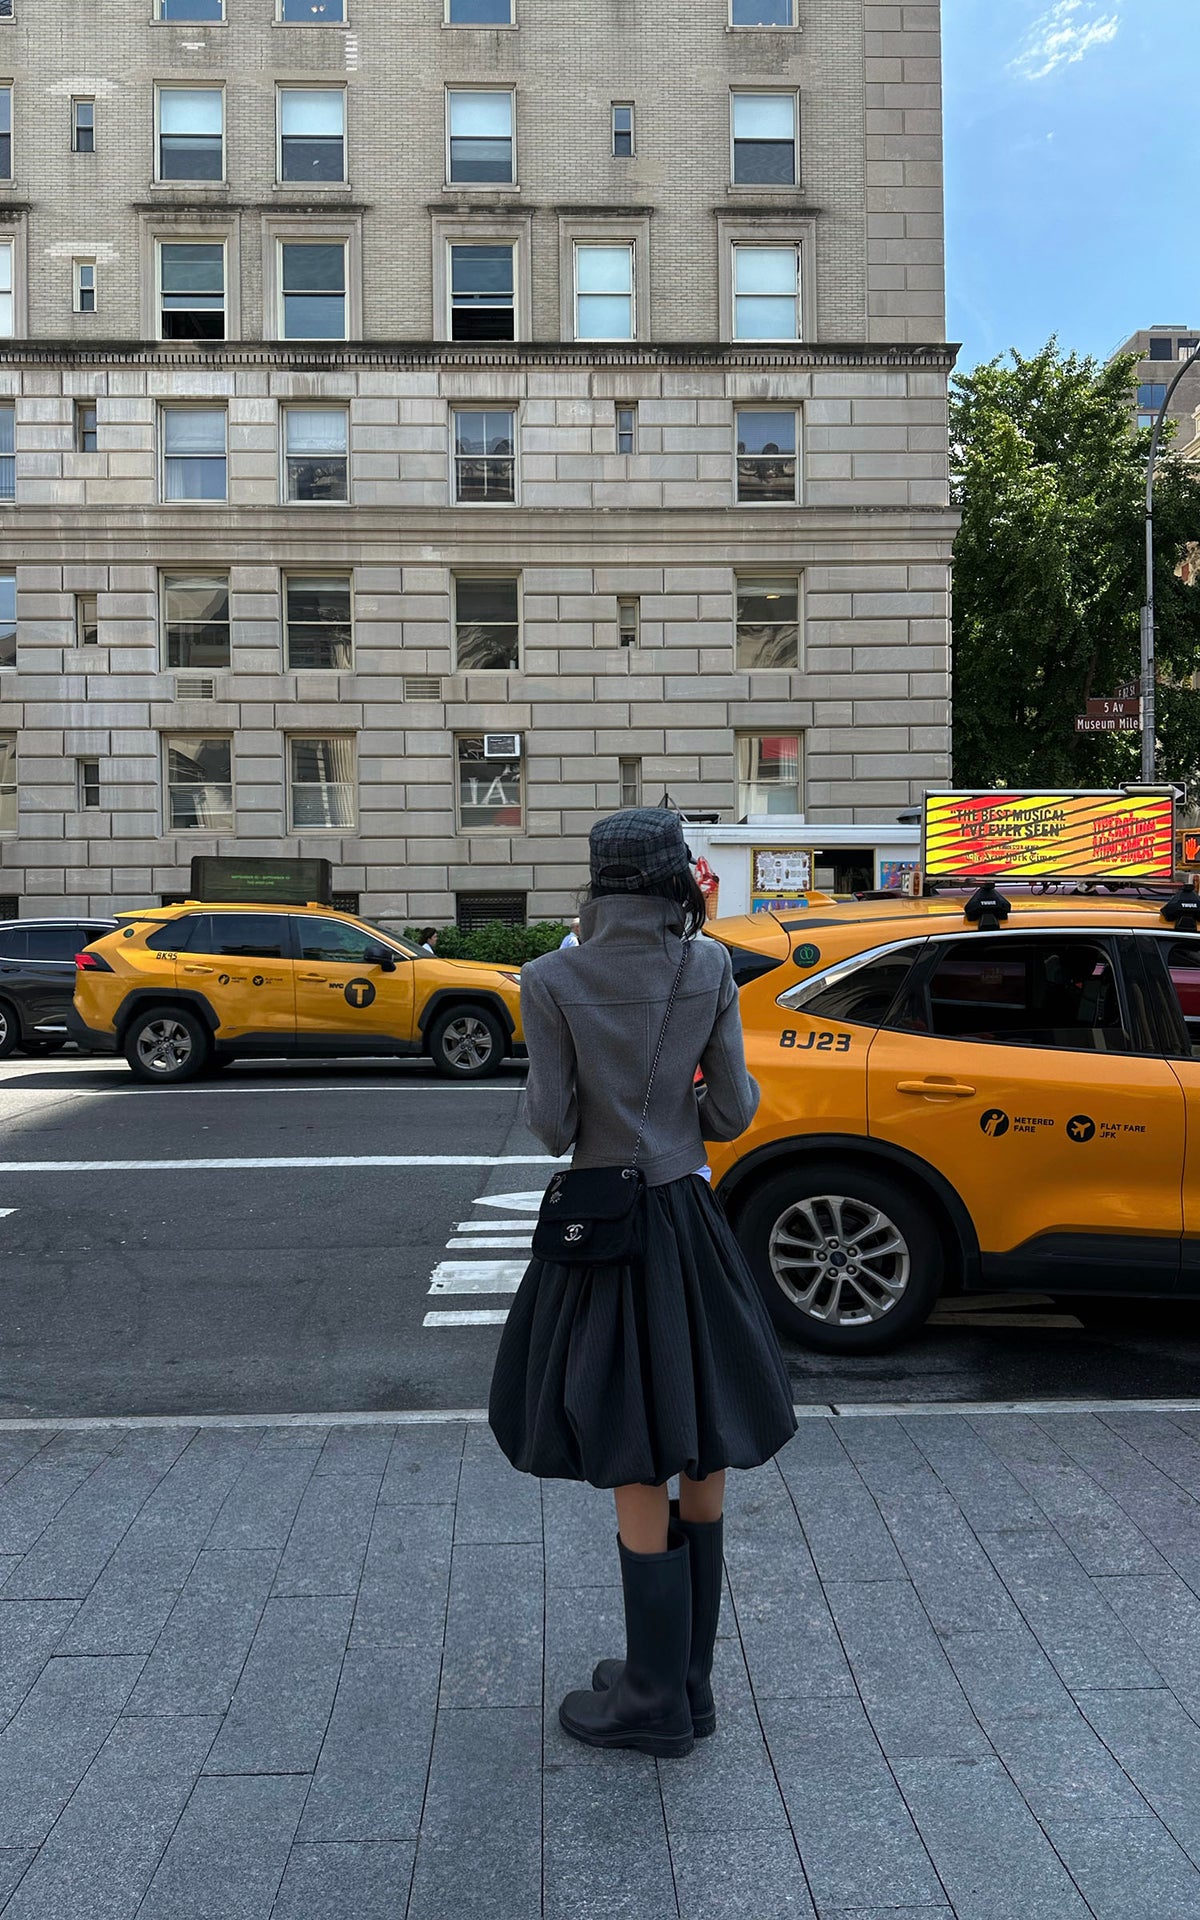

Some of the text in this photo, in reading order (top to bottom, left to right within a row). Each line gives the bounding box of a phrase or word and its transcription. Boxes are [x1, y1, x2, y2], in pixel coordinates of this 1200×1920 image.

[1130, 685, 1135, 696] St
[1104, 702, 1124, 713] 5 Av
[1077, 717, 1139, 730] Museum Mile
[981, 809, 1012, 822] BEST
[1013, 809, 1066, 822] MUSICAL
[988, 823, 1022, 837] EVER
[351, 983, 369, 1005] T
[779, 1029, 852, 1052] 8J23
[1013, 1116, 1055, 1127] METERED
[1013, 1124, 1036, 1133] FARE
[1100, 1122, 1146, 1133] FLAT FARE
[1099, 1131, 1117, 1139] JFK
